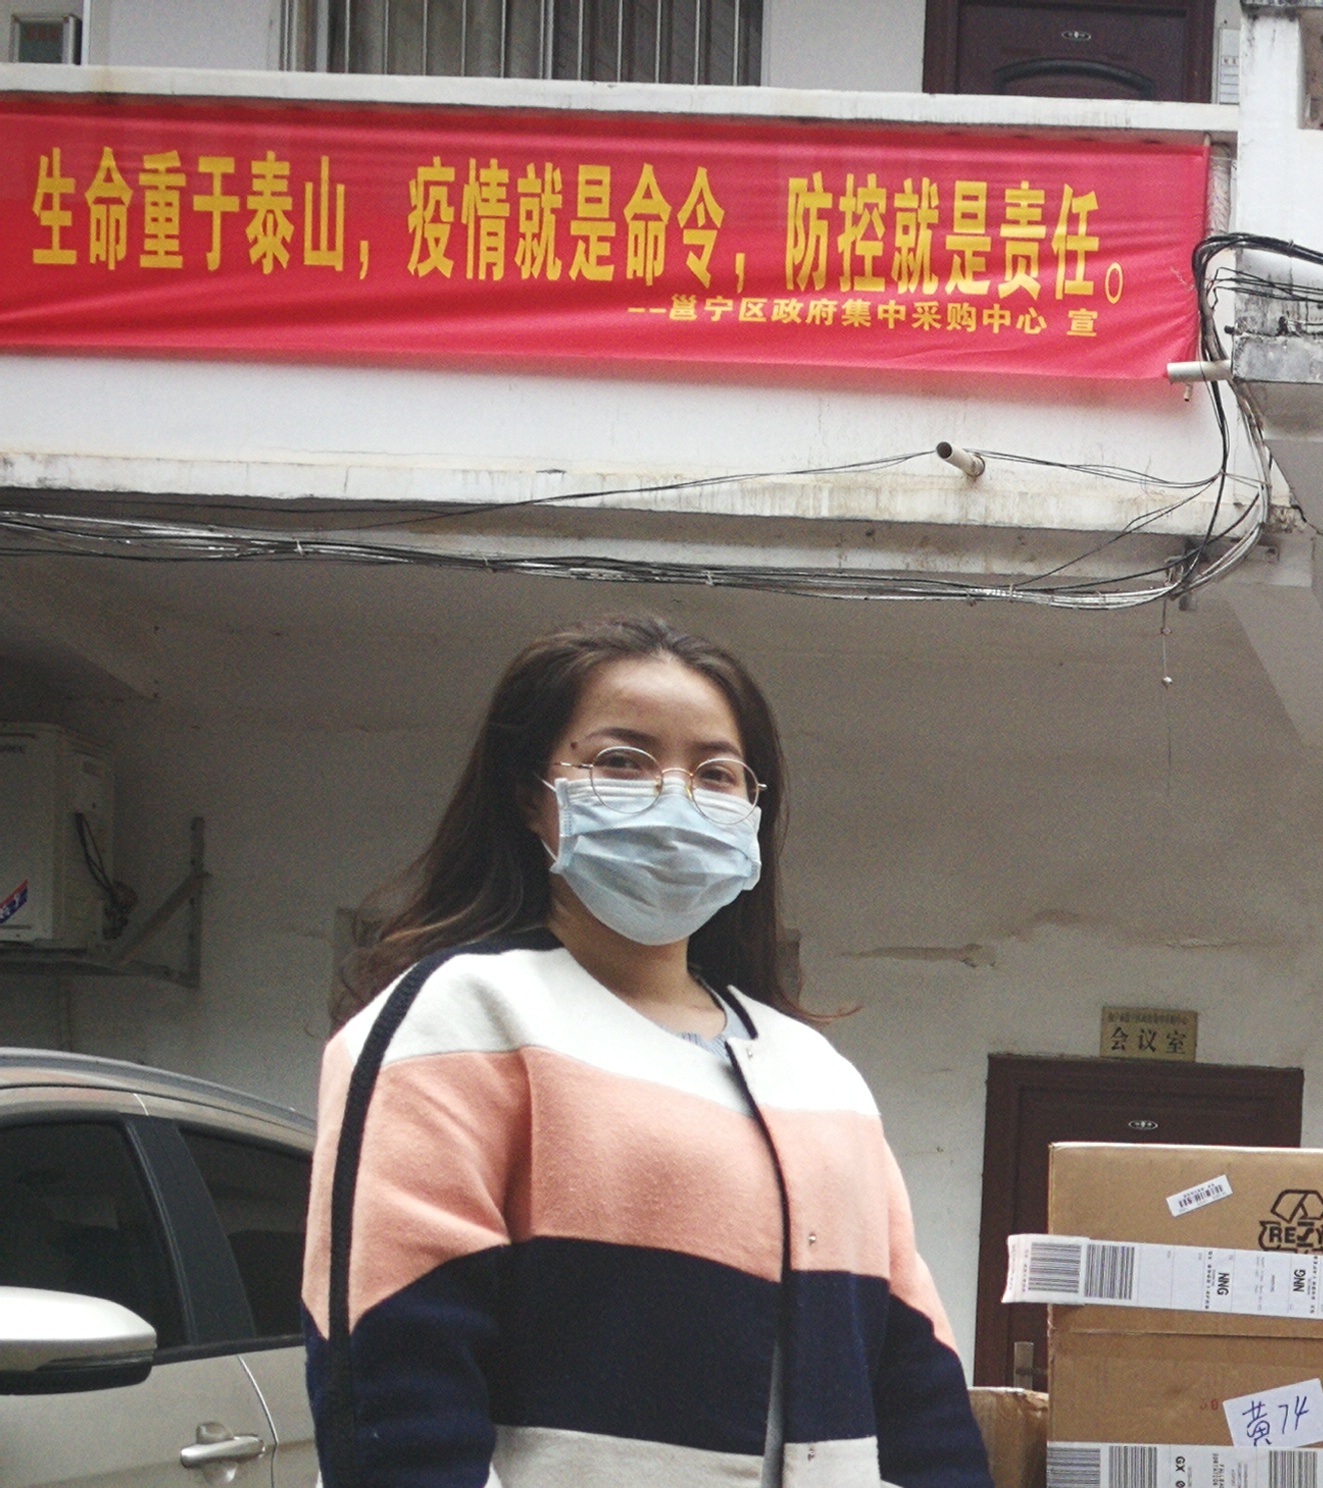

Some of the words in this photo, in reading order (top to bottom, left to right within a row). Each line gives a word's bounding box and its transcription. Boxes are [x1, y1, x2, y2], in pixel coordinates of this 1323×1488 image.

[32, 146, 370, 280] 生命重于泰山，
[406, 155, 747, 293] 疫情就是命令，
[785, 170, 1125, 305] 防控就是责任。
[1066, 309, 1099, 338] 宣
[1111, 1026, 1186, 1055] 会议室
[1217, 1272, 1230, 1296] NNG
[1293, 1269, 1306, 1293] NNG
